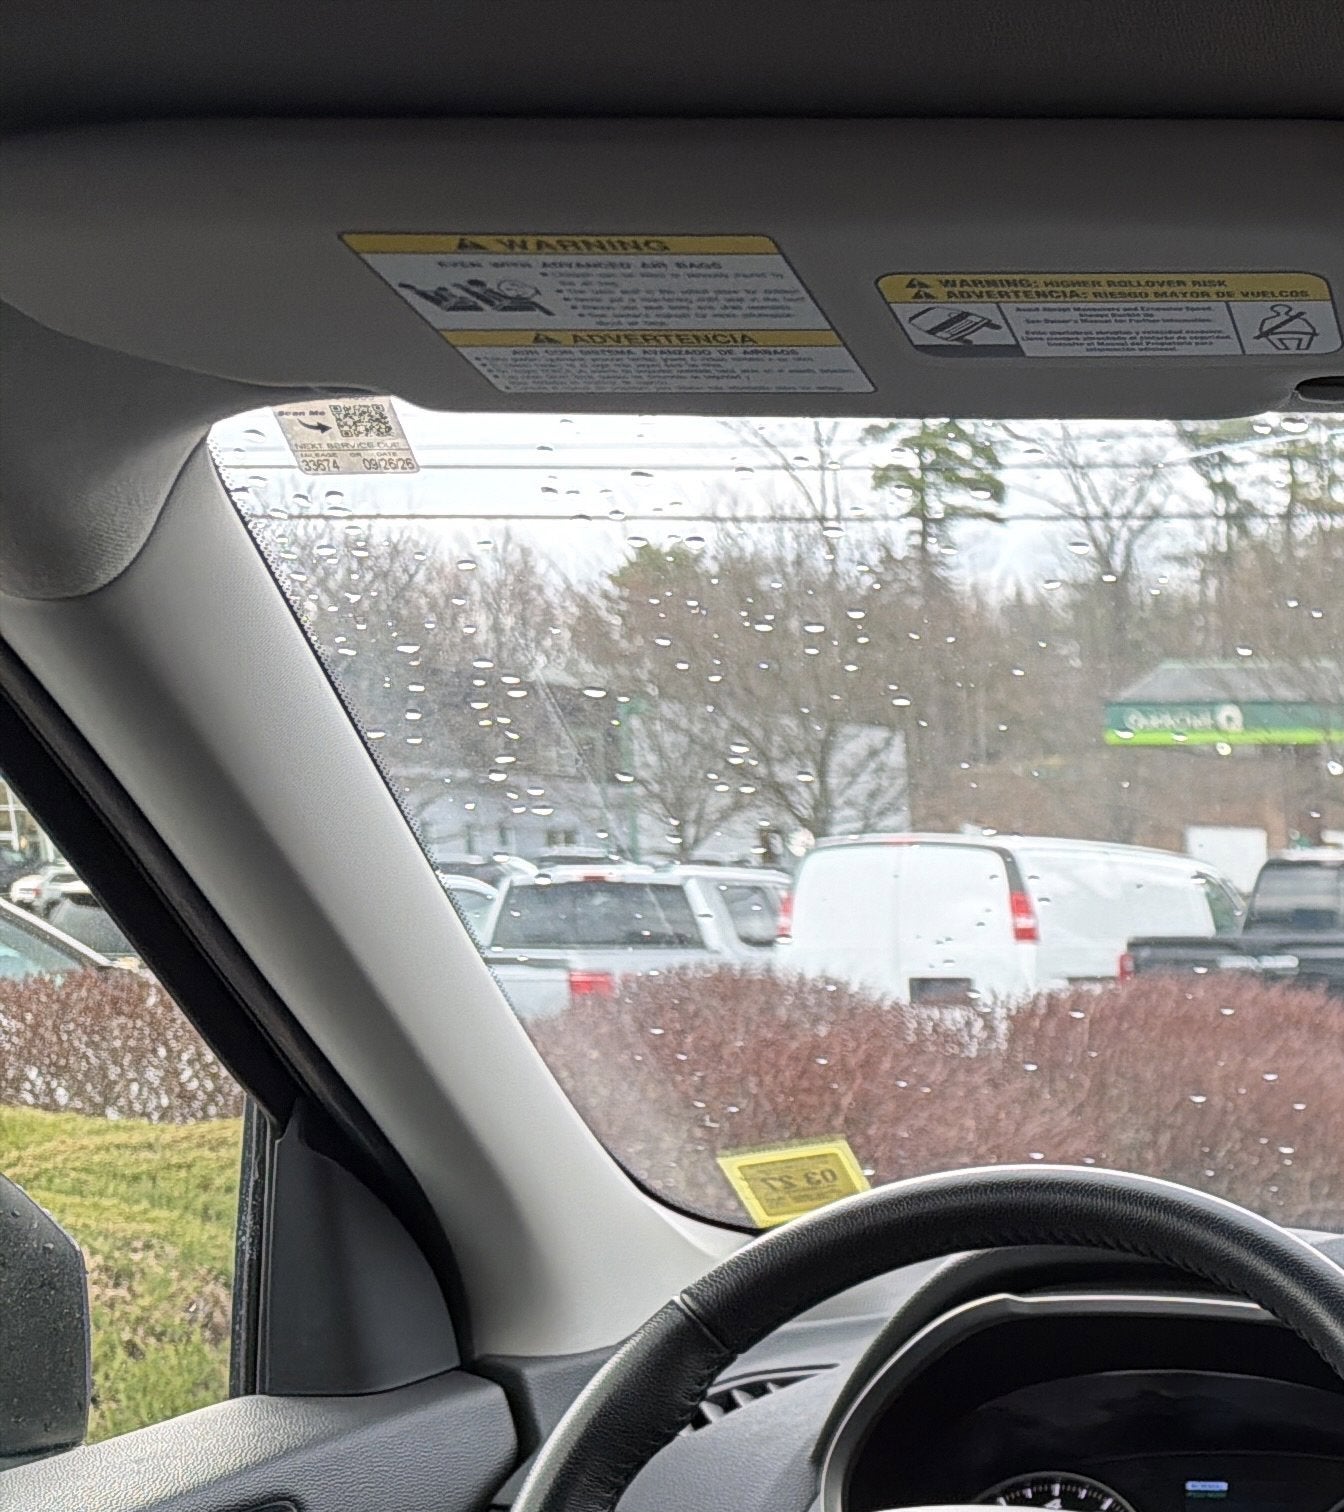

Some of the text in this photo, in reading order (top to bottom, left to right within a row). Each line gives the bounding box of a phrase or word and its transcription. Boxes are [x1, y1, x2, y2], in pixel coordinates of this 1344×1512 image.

[496, 239, 670, 251] WARNING
[938, 278, 1037, 288] WARNING:
[1043, 279, 1102, 287] HIGHER
[946, 290, 1309, 299] ADVERTENCIA: RIESGO MAYOR DE VUELCOS
[571, 333, 758, 345] ADVERTENCIA
[294, 442, 322, 450] NEXT
[326, 442, 374, 450] SERVICE
